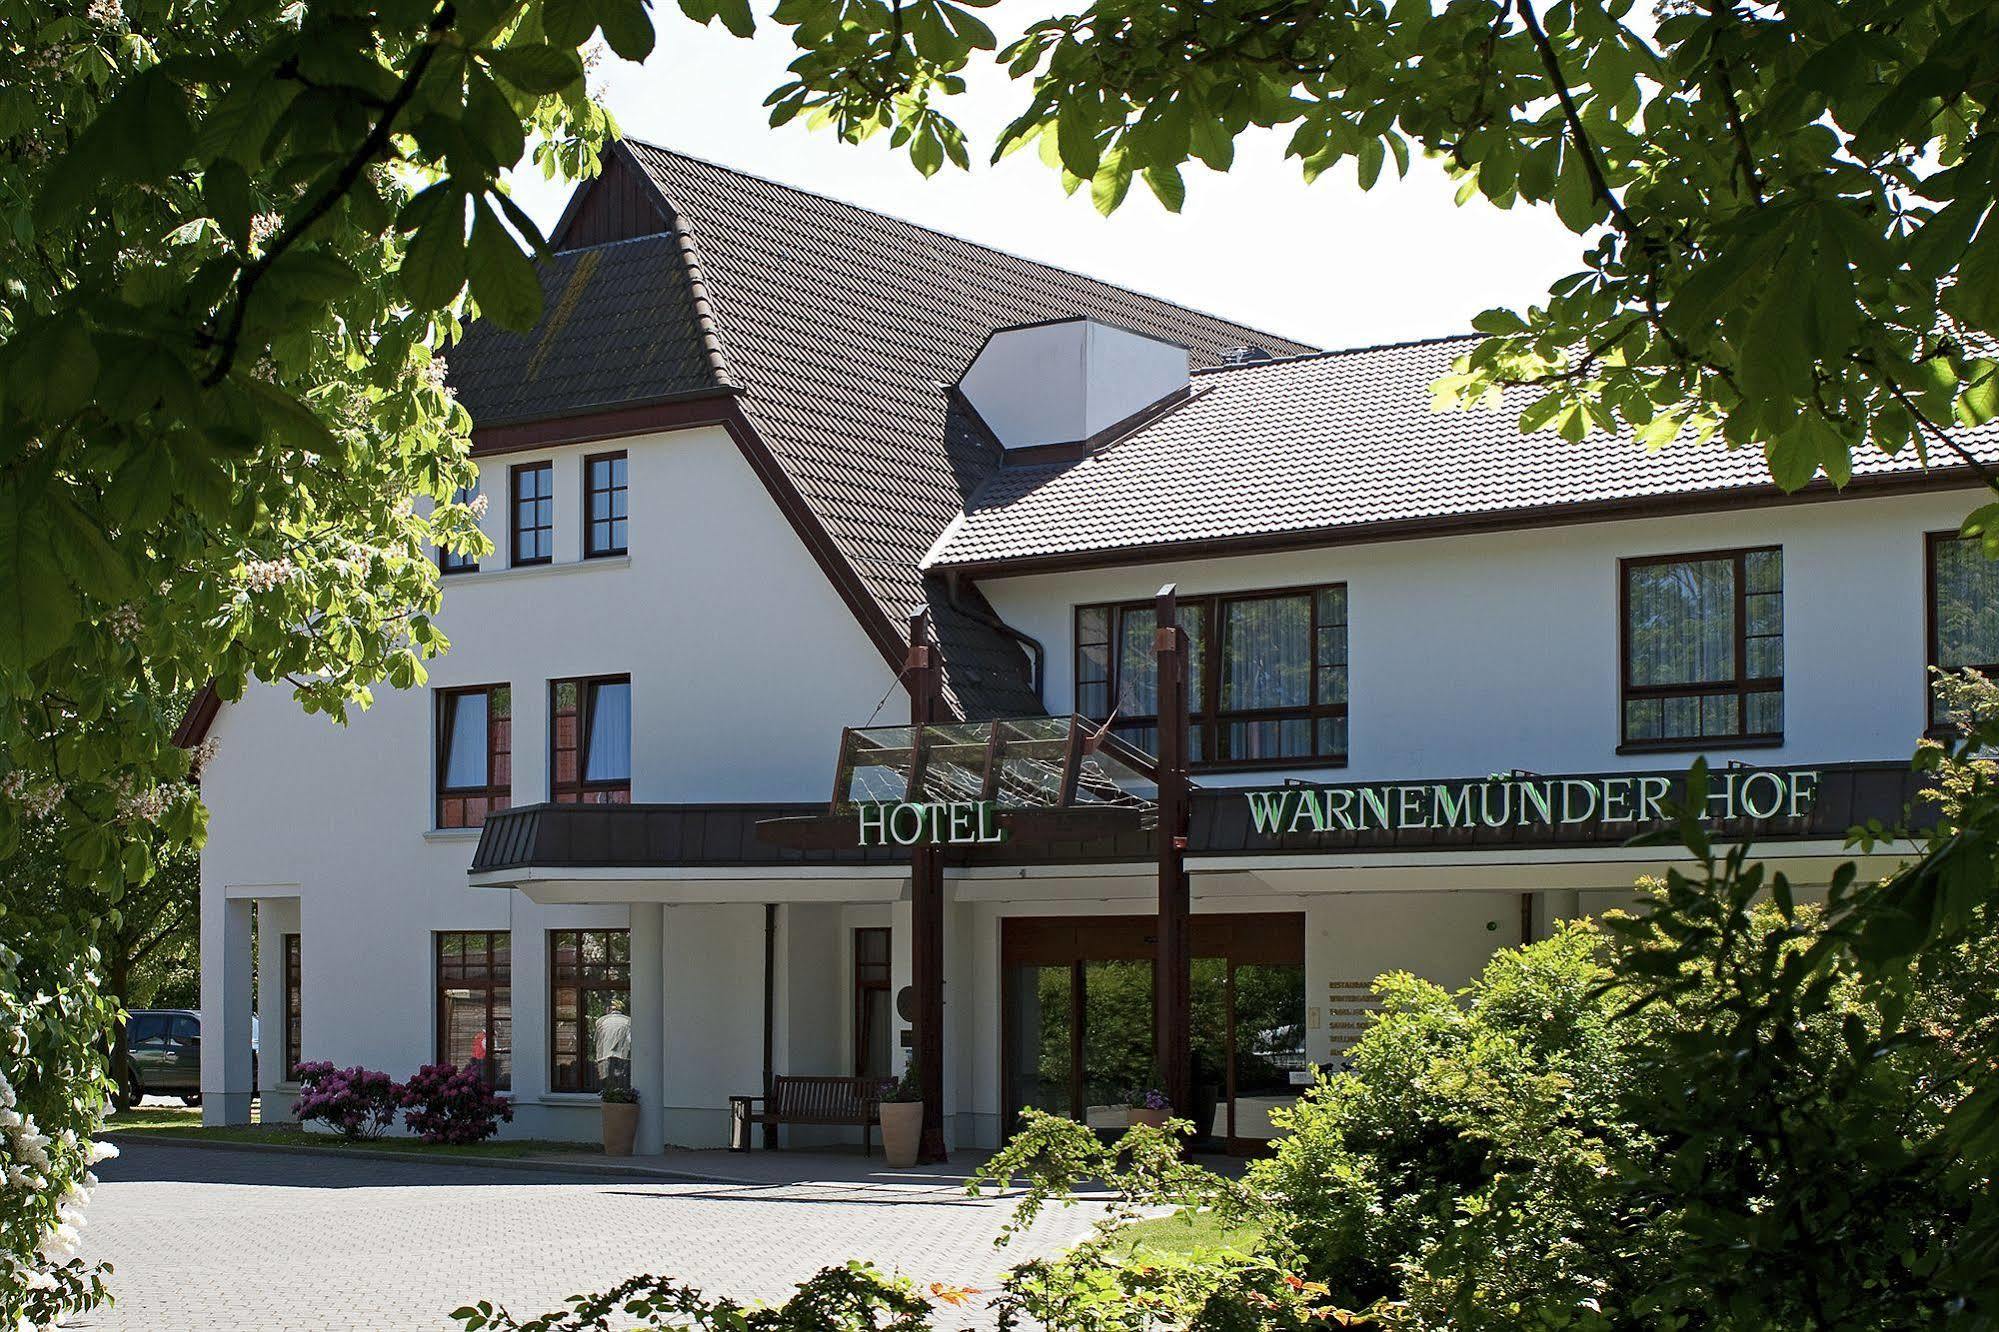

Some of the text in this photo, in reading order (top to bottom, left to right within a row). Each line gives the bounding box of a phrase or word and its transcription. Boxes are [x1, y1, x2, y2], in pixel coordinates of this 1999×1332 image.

[858, 801, 1002, 845] HOTEL
[1245, 771, 1818, 833] WARNEMÜNDER HOF
